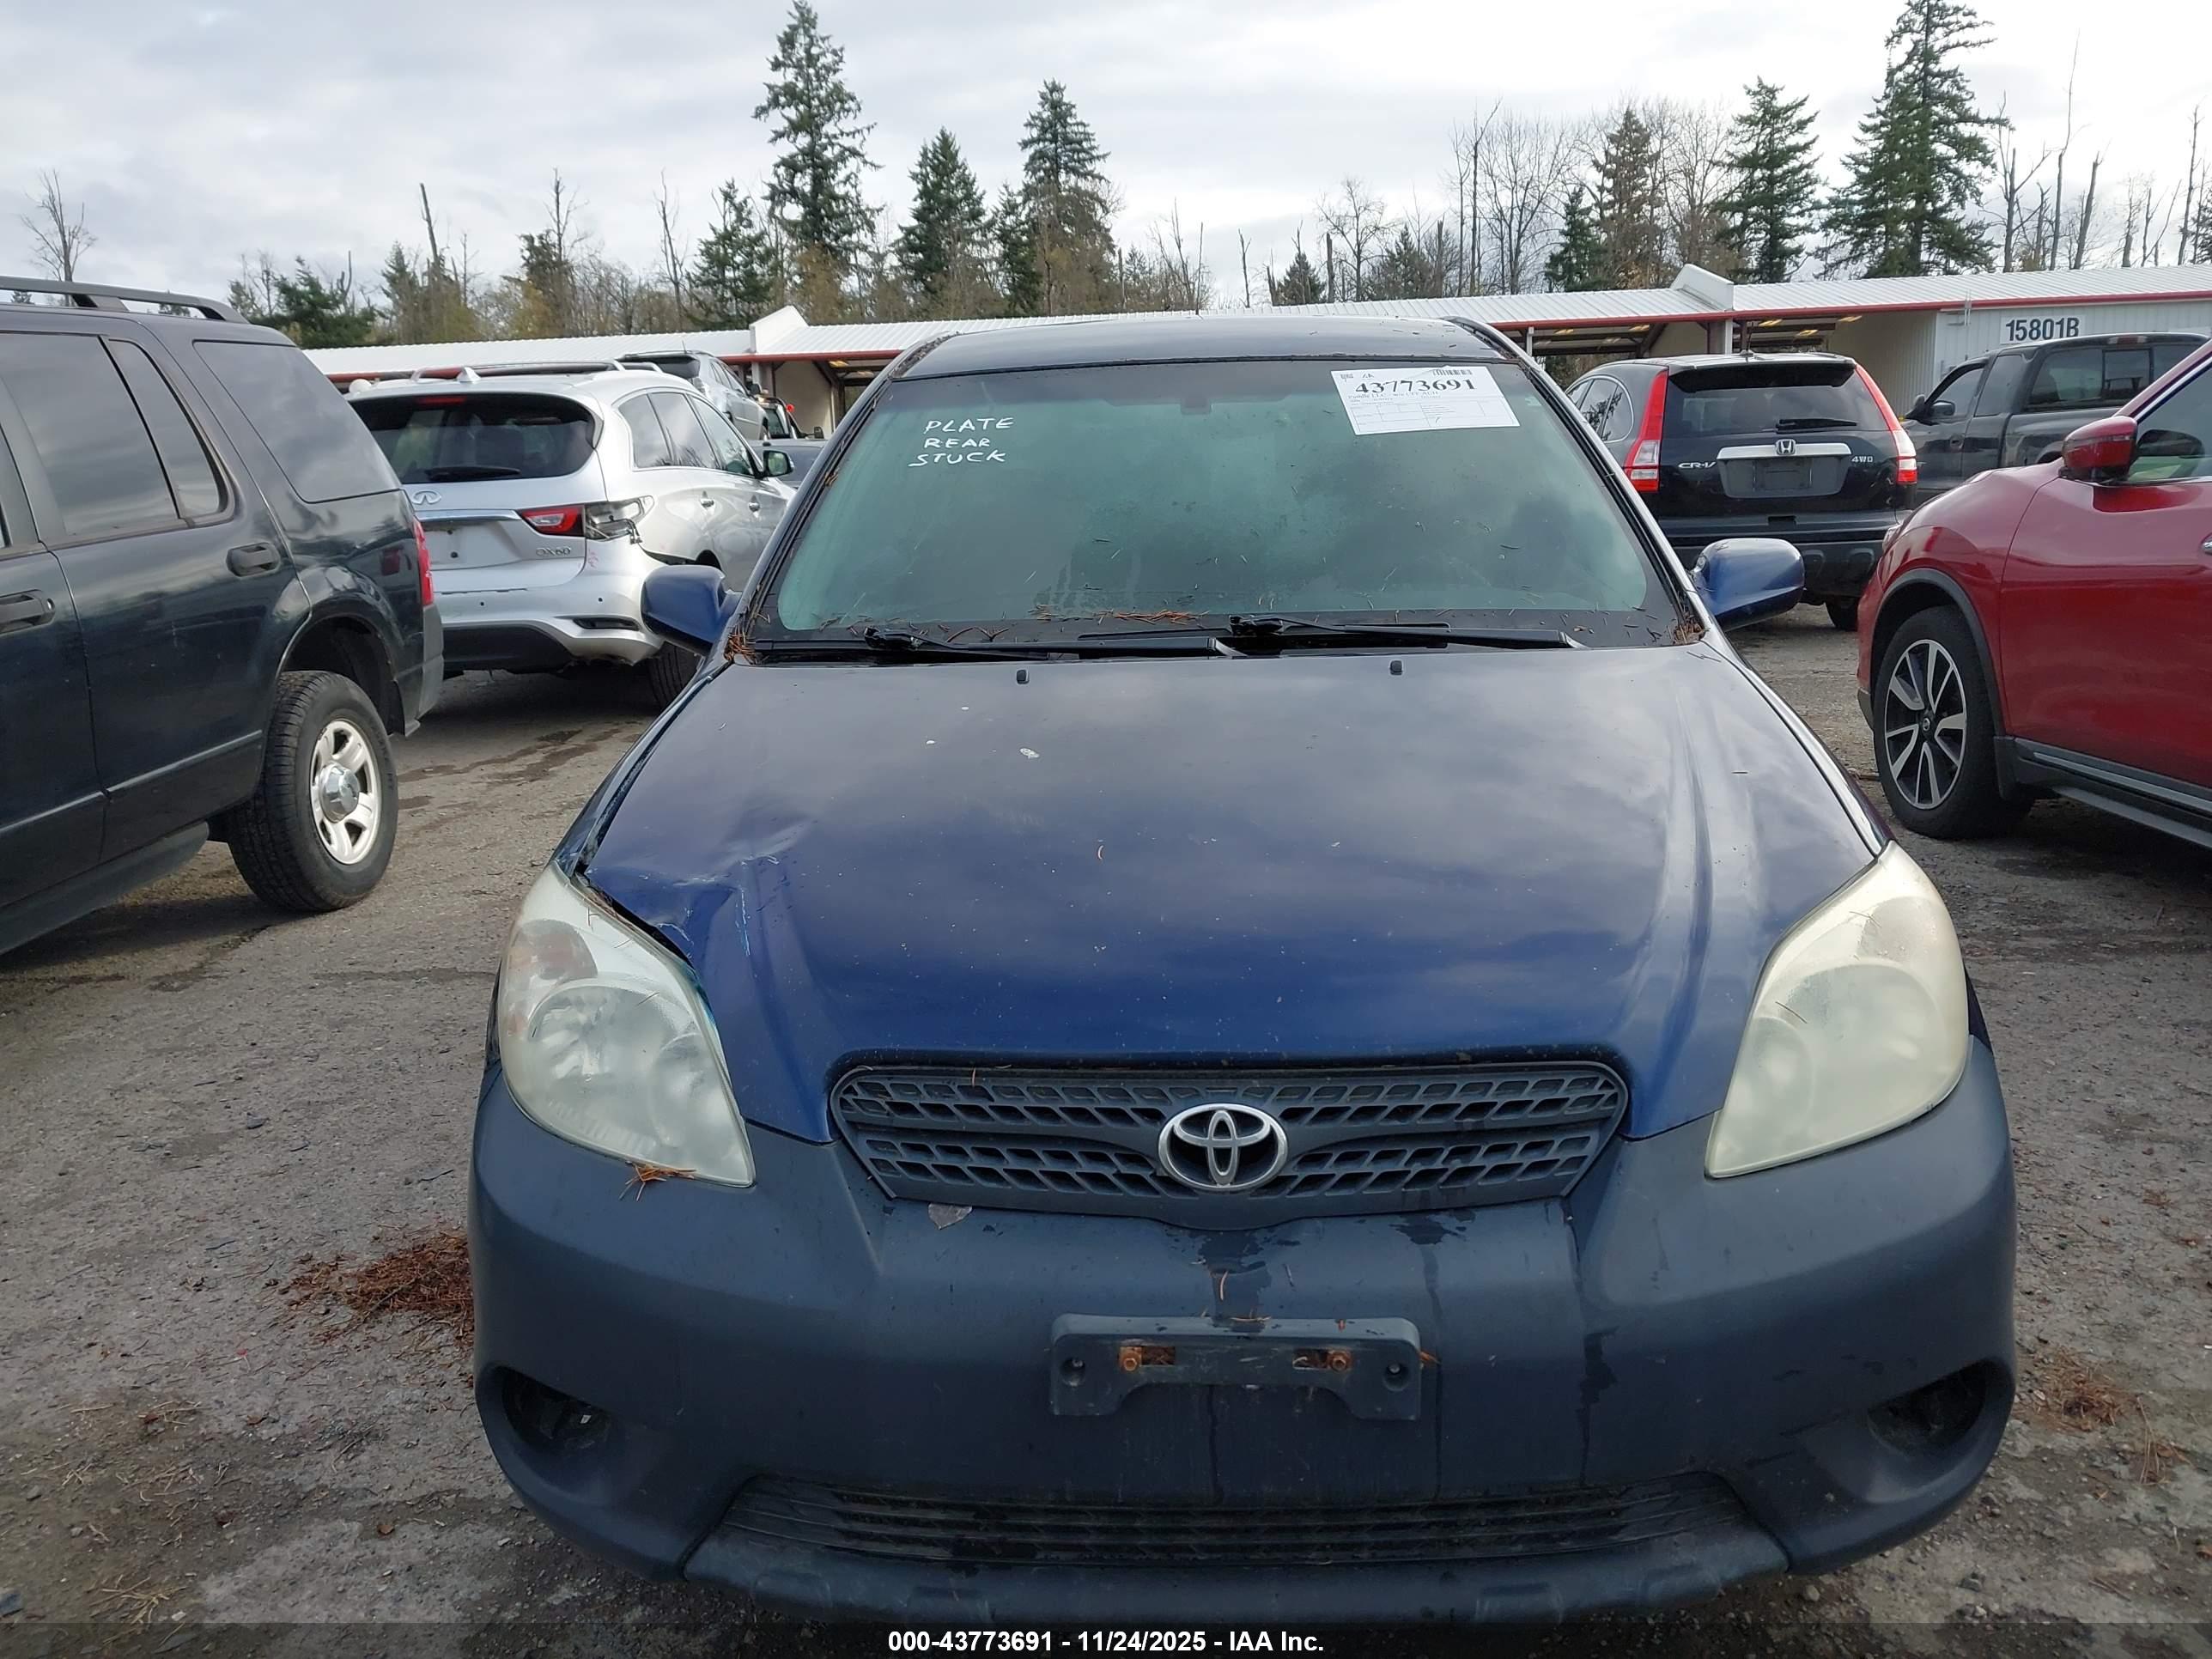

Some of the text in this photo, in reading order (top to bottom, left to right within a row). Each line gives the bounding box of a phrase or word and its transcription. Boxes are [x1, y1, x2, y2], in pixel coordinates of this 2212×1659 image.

[2006, 317, 2080, 341] 15801B
[1355, 379, 1478, 393] 43773691
[923, 417, 1014, 434] PLATE
[924, 438, 991, 448] REAR
[908, 449, 1006, 466] STUCK
